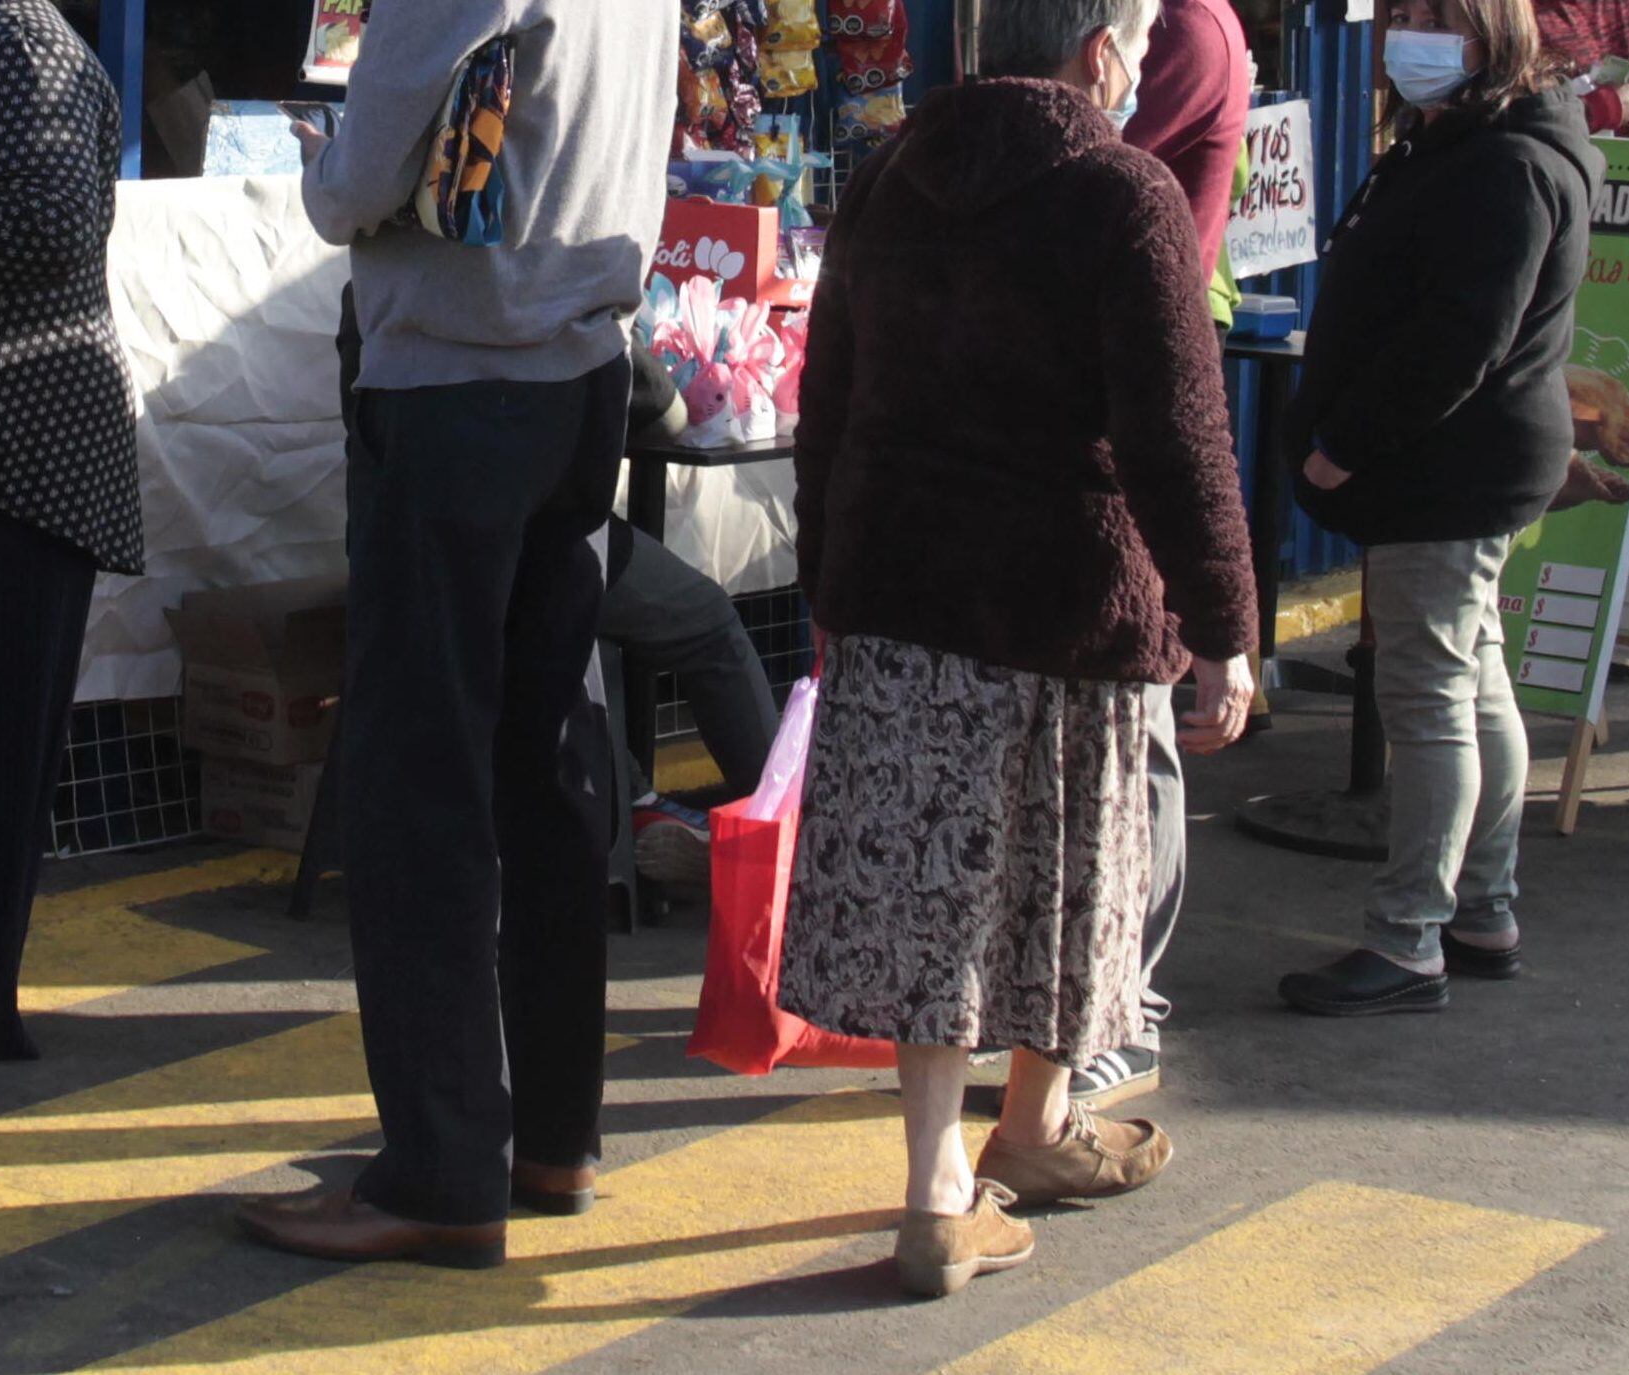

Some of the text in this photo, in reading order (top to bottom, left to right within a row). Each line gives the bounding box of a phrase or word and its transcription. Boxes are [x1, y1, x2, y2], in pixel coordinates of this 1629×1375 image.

[1247, 117, 1290, 165] rros
[656, 239, 691, 267] oli
[1497, 595, 1523, 612] na
